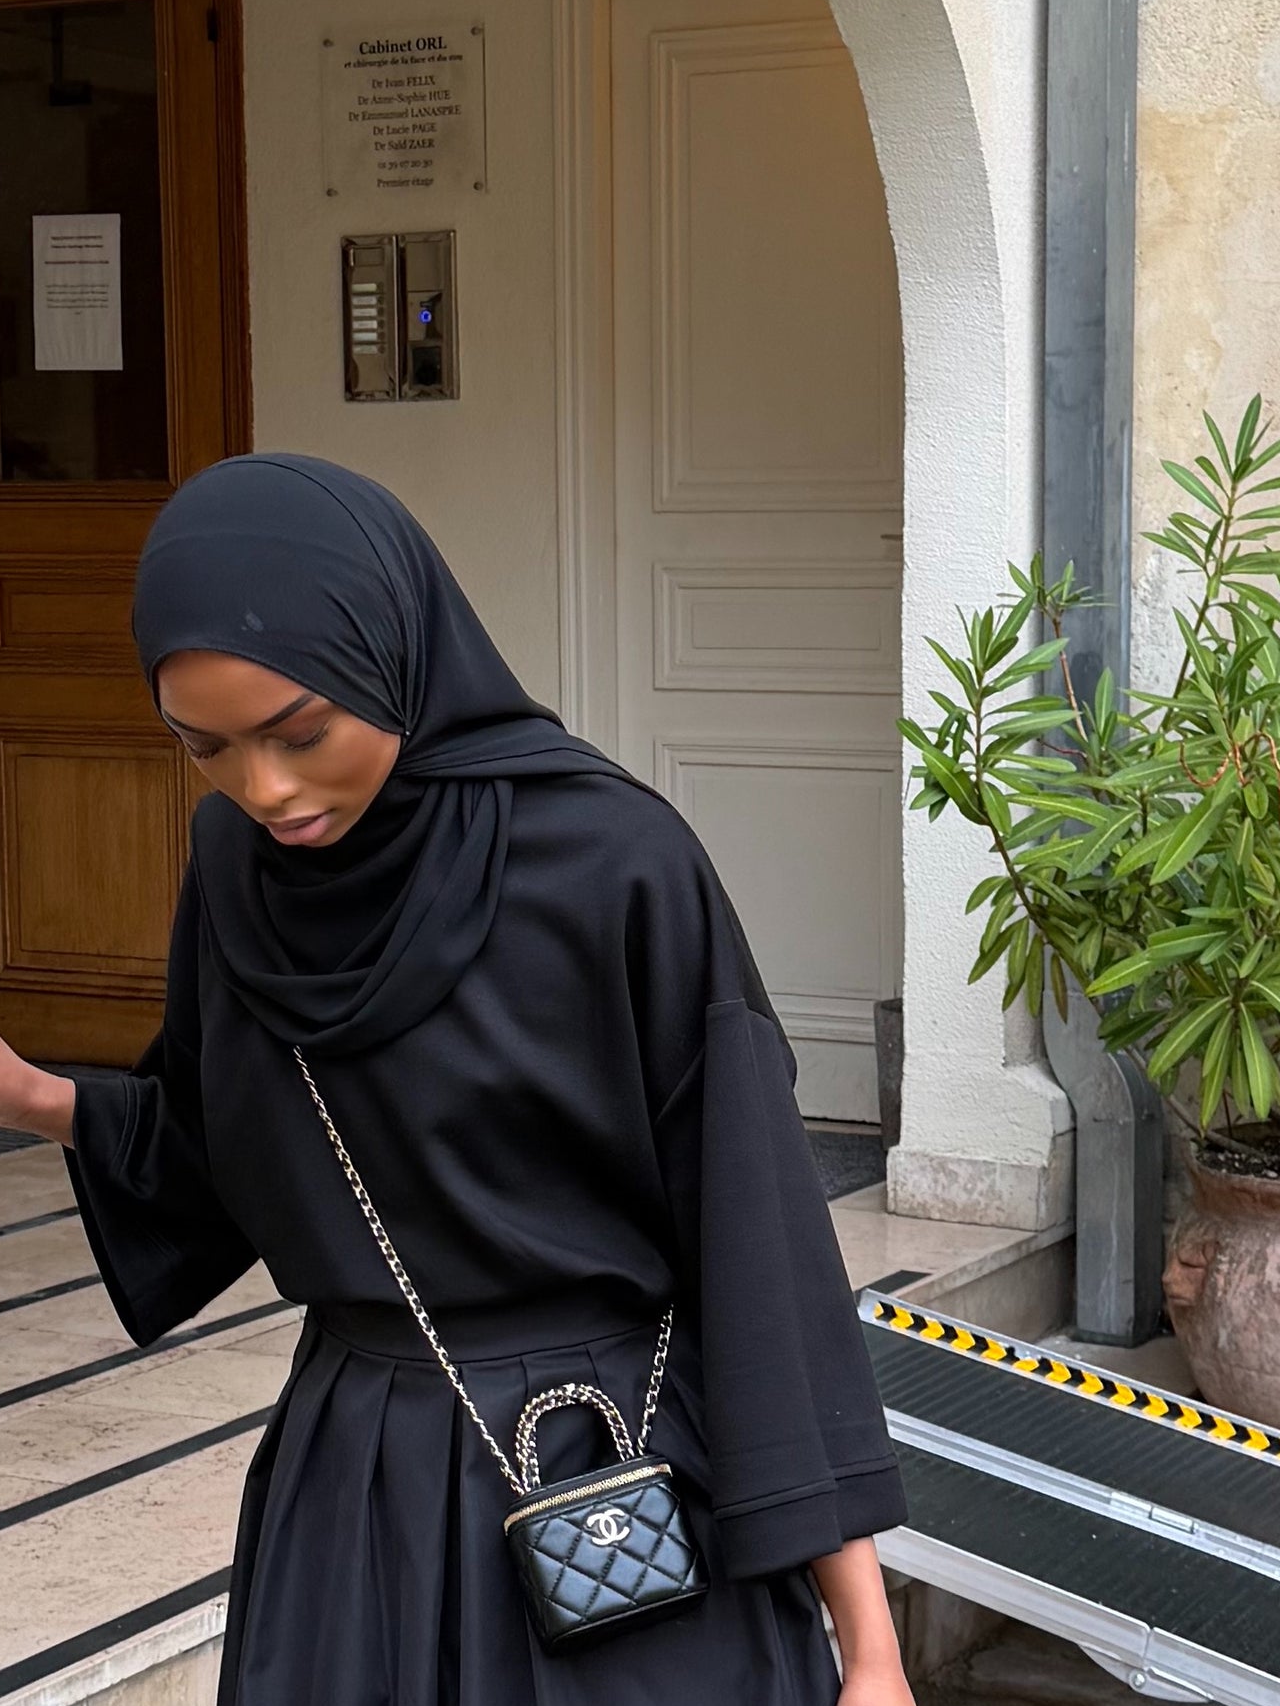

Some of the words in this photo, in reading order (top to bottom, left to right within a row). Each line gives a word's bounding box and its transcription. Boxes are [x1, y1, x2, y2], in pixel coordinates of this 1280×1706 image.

[359, 39, 412, 55] Cabinet
[416, 36, 447, 51] ORL
[390, 57, 399, 65] de
[371, 79, 383, 89] Dr
[406, 75, 436, 87] FELIX
[358, 95, 369, 106] Dr
[429, 90, 451, 101] HUE
[348, 112, 360, 122] Dr
[373, 125, 384, 135] Dr
[386, 125, 410, 135] Lucie
[374, 141, 386, 151] Dr
